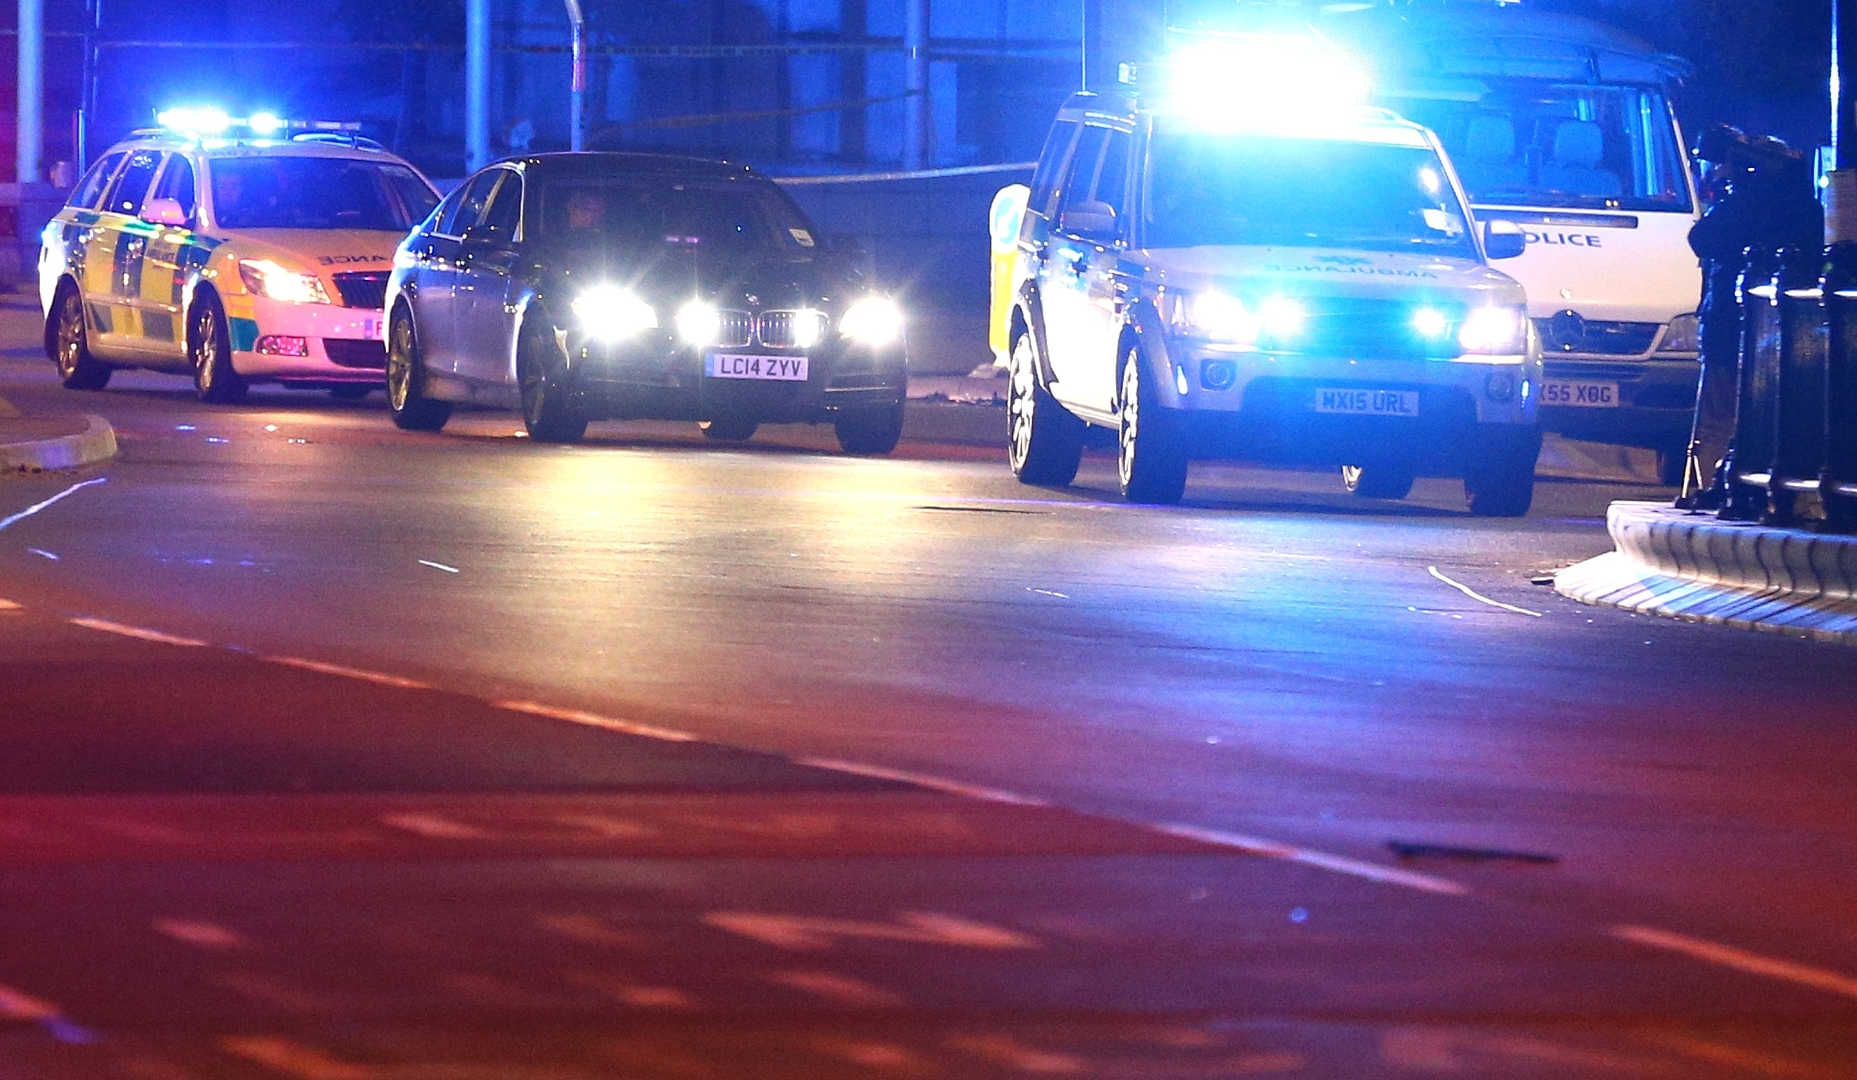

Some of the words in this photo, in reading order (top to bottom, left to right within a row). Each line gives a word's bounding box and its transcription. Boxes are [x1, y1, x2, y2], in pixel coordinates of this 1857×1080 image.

[1525, 232, 1602, 248] OLICE
[720, 357, 760, 376] LC14
[766, 359, 801, 376] ZYV
[1373, 393, 1411, 413] URL
